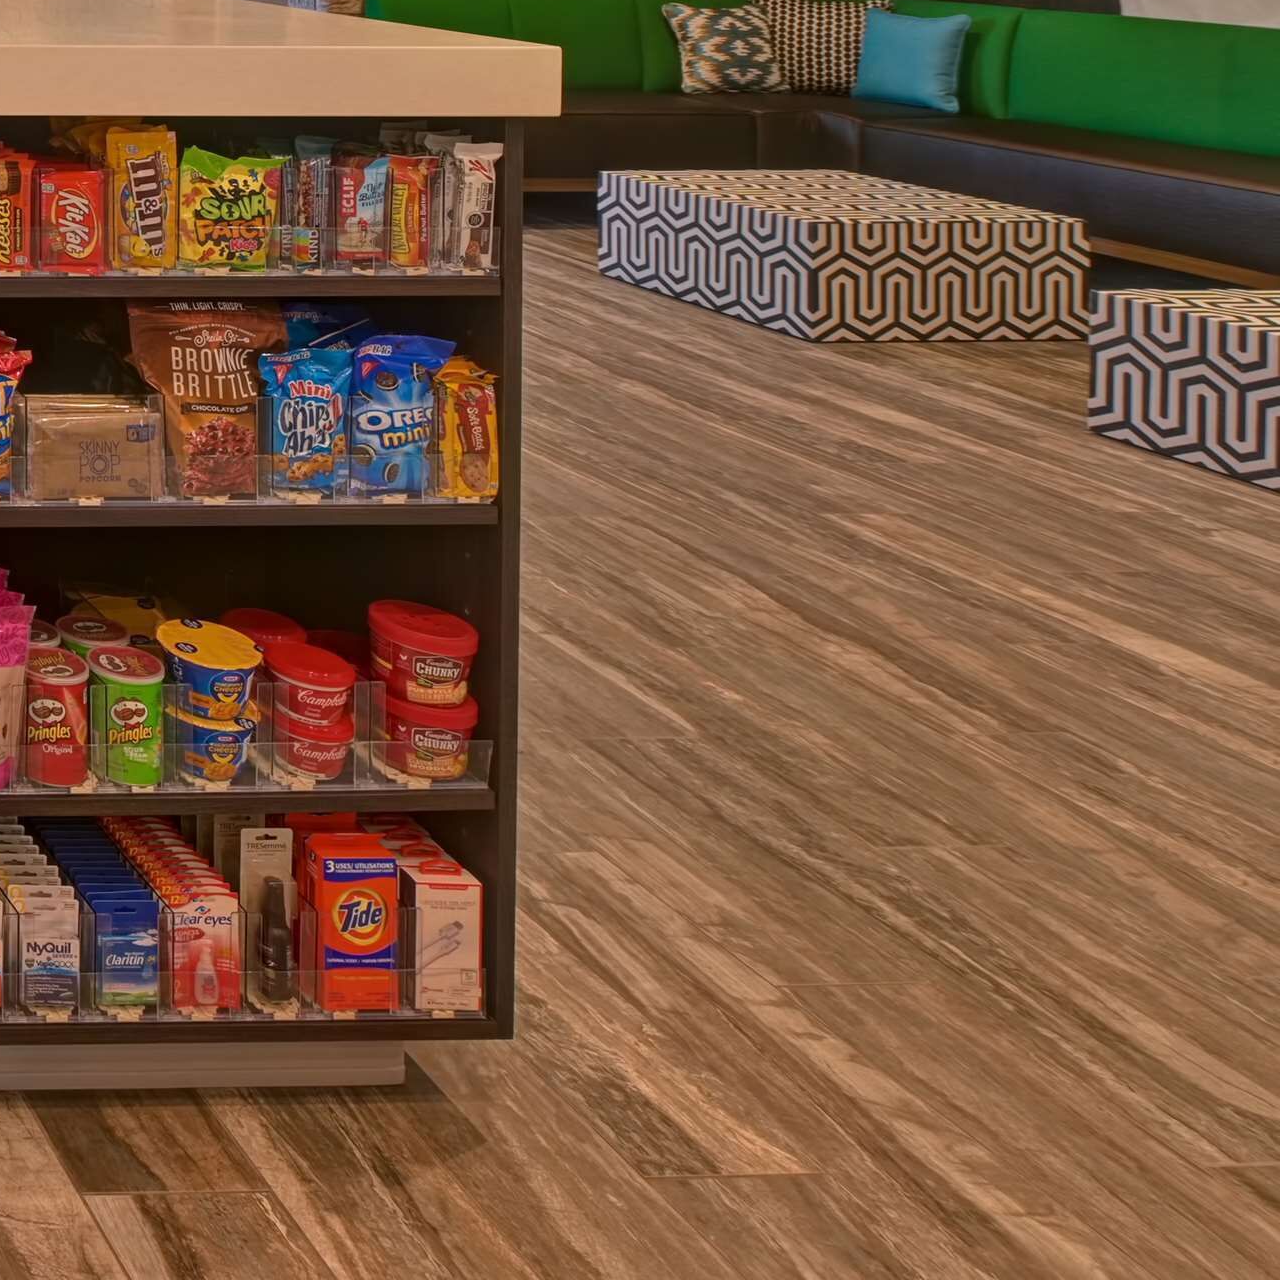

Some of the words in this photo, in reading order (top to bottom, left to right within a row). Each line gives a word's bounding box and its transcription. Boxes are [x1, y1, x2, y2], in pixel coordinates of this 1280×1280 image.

[200, 193, 267, 221] SOUR
[309, 229, 319, 264] KIND
[170, 346, 255, 373] BROWNIE
[172, 372, 258, 400] BRITTLE
[289, 380, 333, 399] Mini
[191, 404, 235, 413] CHOCOLATE
[279, 400, 330, 434] Chips
[78, 440, 120, 454] SKINNY
[78, 454, 121, 476] POP
[79, 474, 122, 482] POPCORN
[416, 662, 460, 679] CHUNKY
[27, 723, 71, 743] Pringles
[109, 724, 153, 744] Pringles
[415, 734, 460, 752] CHUNKY
[325, 860, 335, 873] 3
[204, 915, 233, 928] eyes
[339, 899, 384, 933] Tide
[26, 942, 72, 957] NyQuil
[105, 952, 144, 967] Claritin
